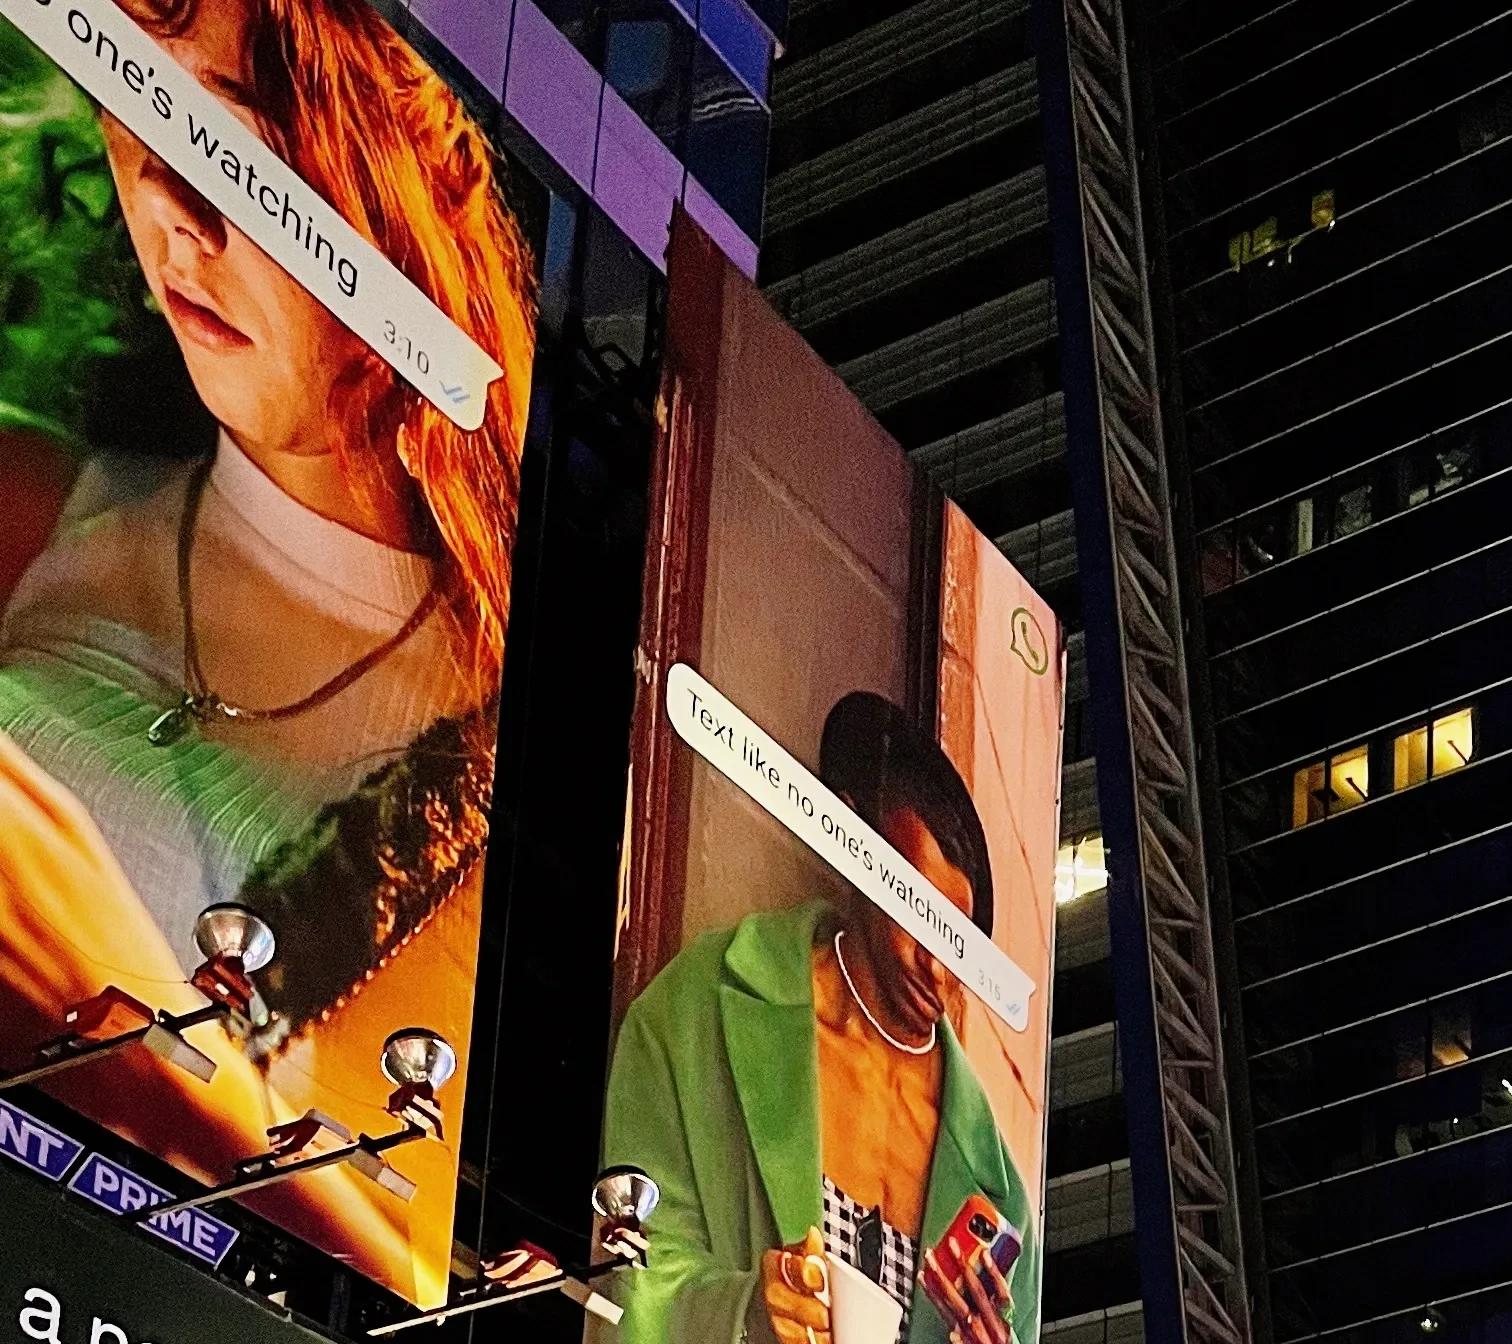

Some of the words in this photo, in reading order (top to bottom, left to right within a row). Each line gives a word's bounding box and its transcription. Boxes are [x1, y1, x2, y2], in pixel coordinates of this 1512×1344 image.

[68, 9, 173, 119] one's
[188, 112, 358, 298] watching
[688, 689, 737, 752] Text
[742, 736, 781, 789] like
[787, 781, 815, 818] no
[821, 814, 874, 872] one's
[879, 865, 966, 960] watching
[94, 1163, 219, 1257] PRIME
